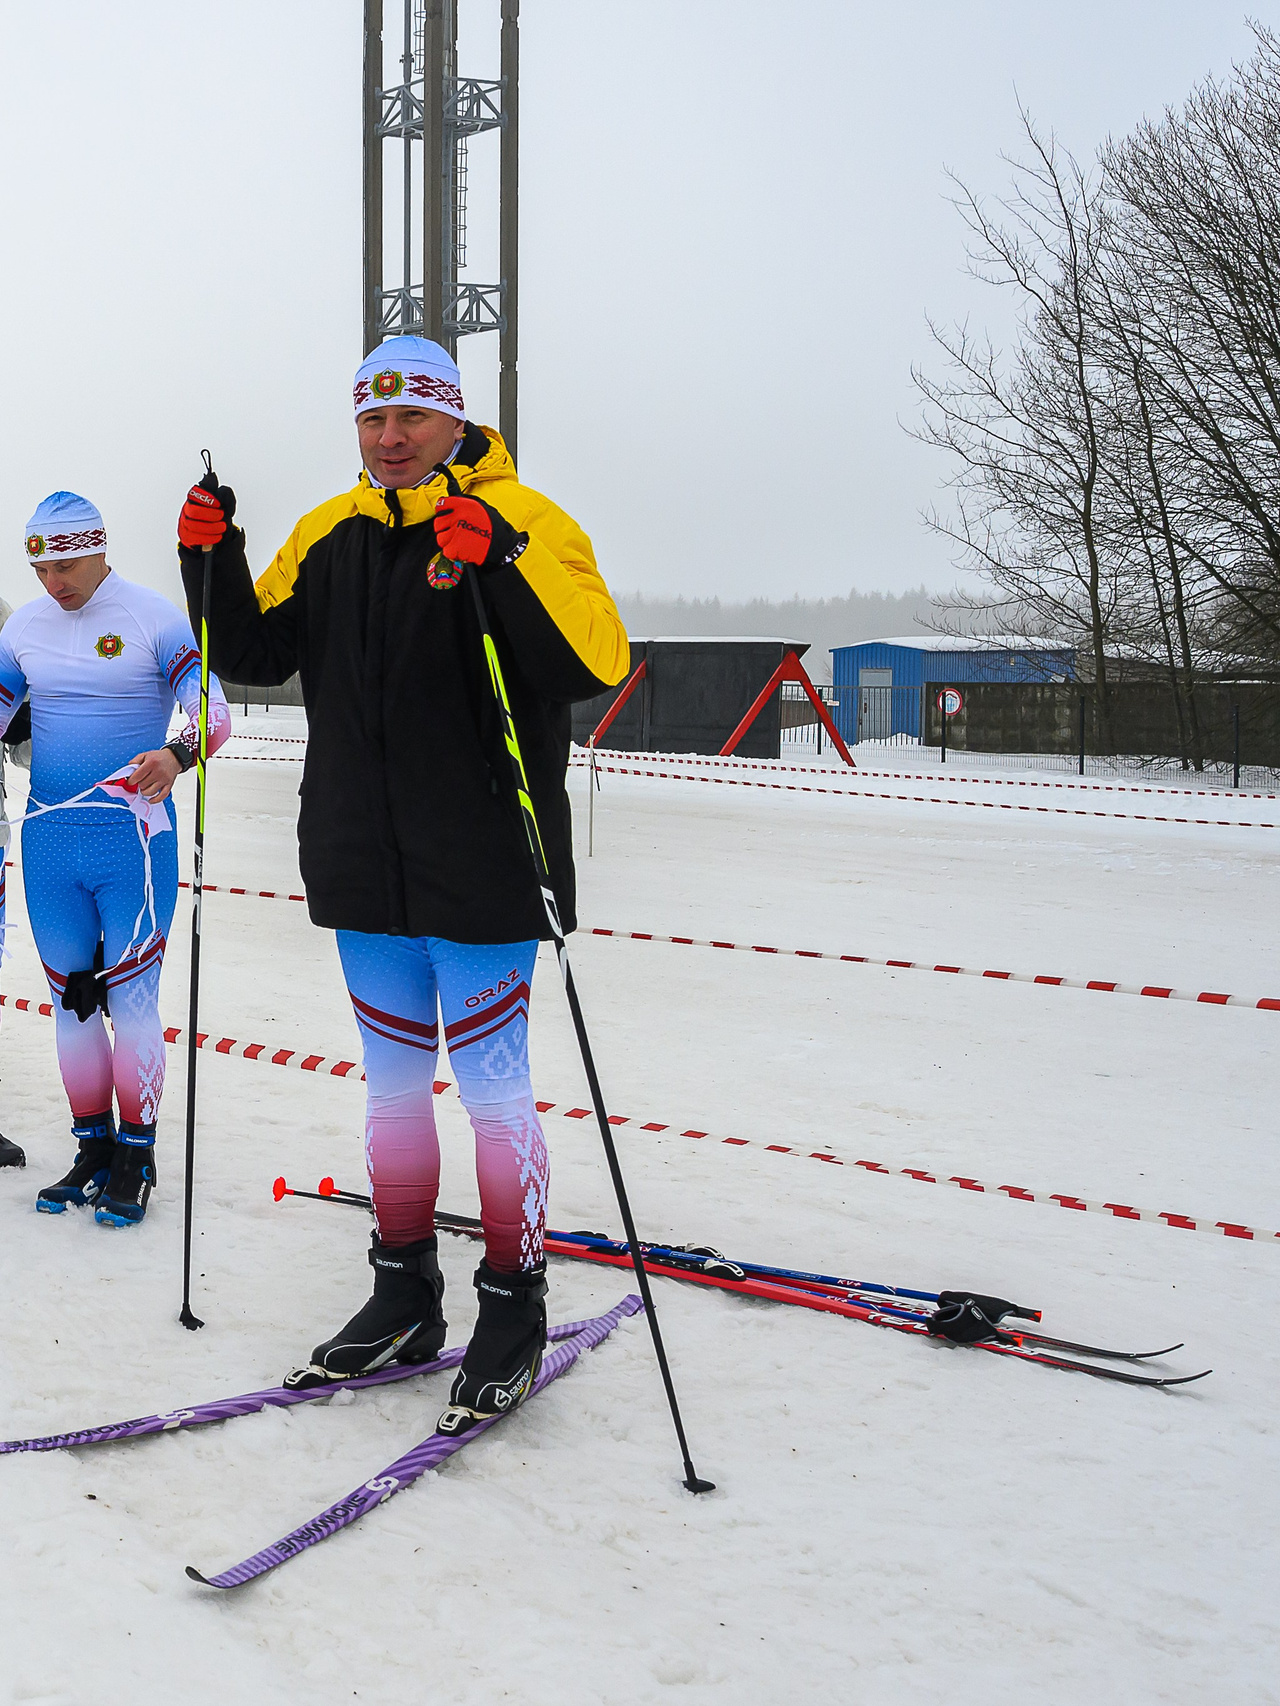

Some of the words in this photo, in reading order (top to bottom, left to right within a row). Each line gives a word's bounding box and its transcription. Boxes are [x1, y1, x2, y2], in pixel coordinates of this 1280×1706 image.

[190, 490, 215, 505] oeckl
[457, 519, 492, 539] Roeck
[464, 968, 520, 1008] ORAZ
